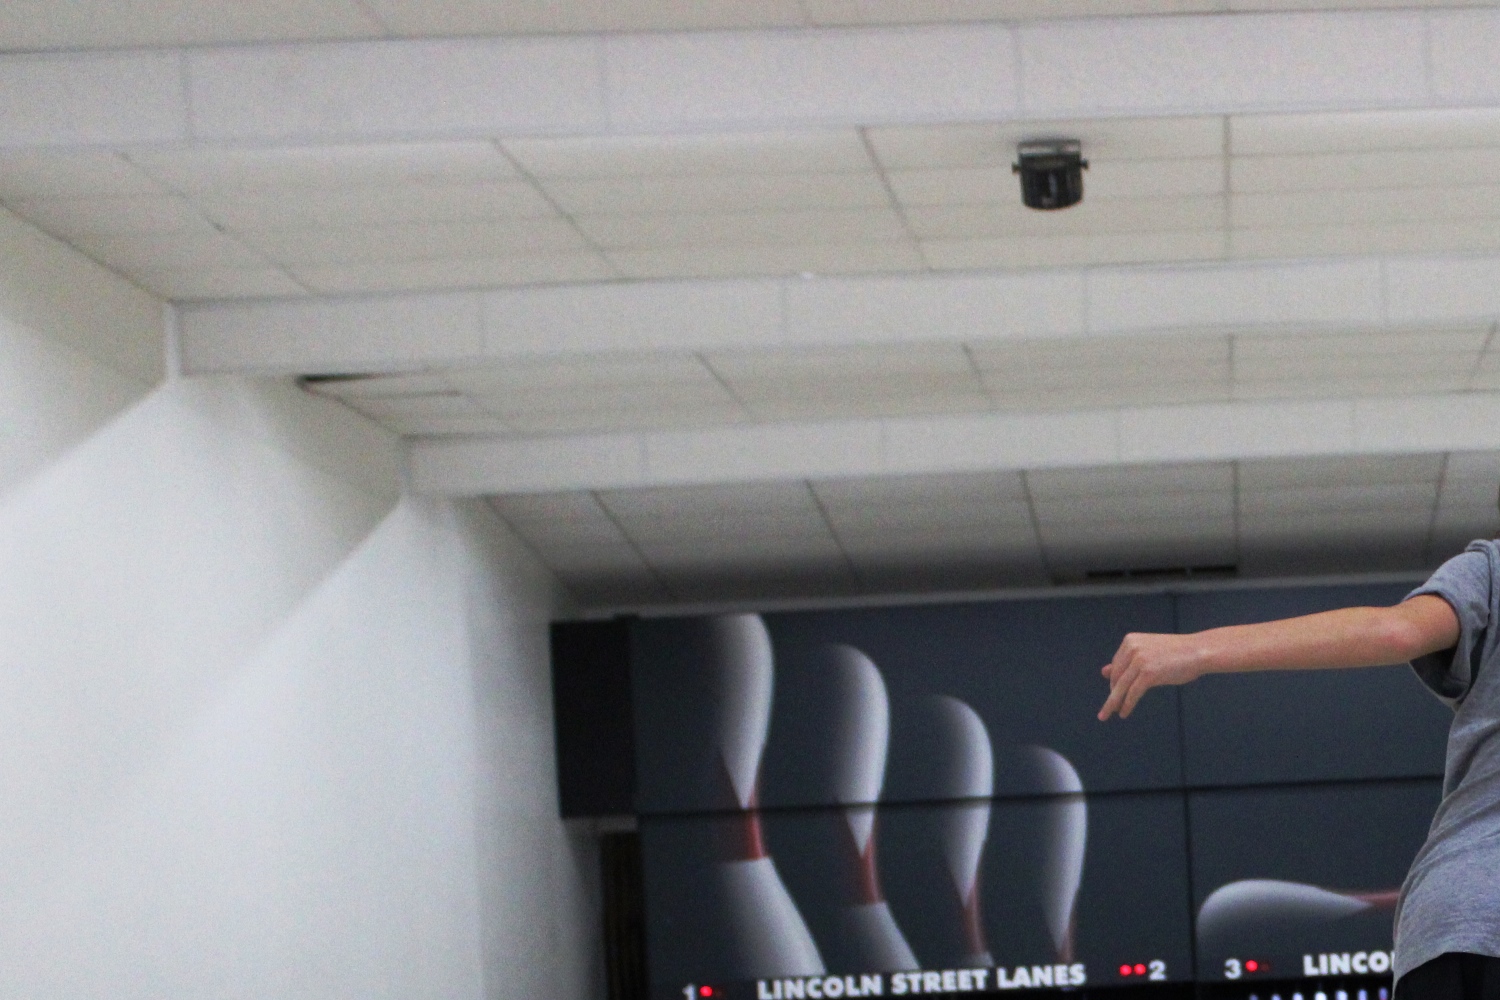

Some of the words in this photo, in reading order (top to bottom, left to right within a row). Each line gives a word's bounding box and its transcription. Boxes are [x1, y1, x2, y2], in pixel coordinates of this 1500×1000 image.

[1148, 960, 1166, 981] 2
[1224, 958, 1242, 980] 3
[1303, 950, 1395, 977] LINCO
[891, 968, 988, 995] STREET
[996, 963, 1086, 989] LANES
